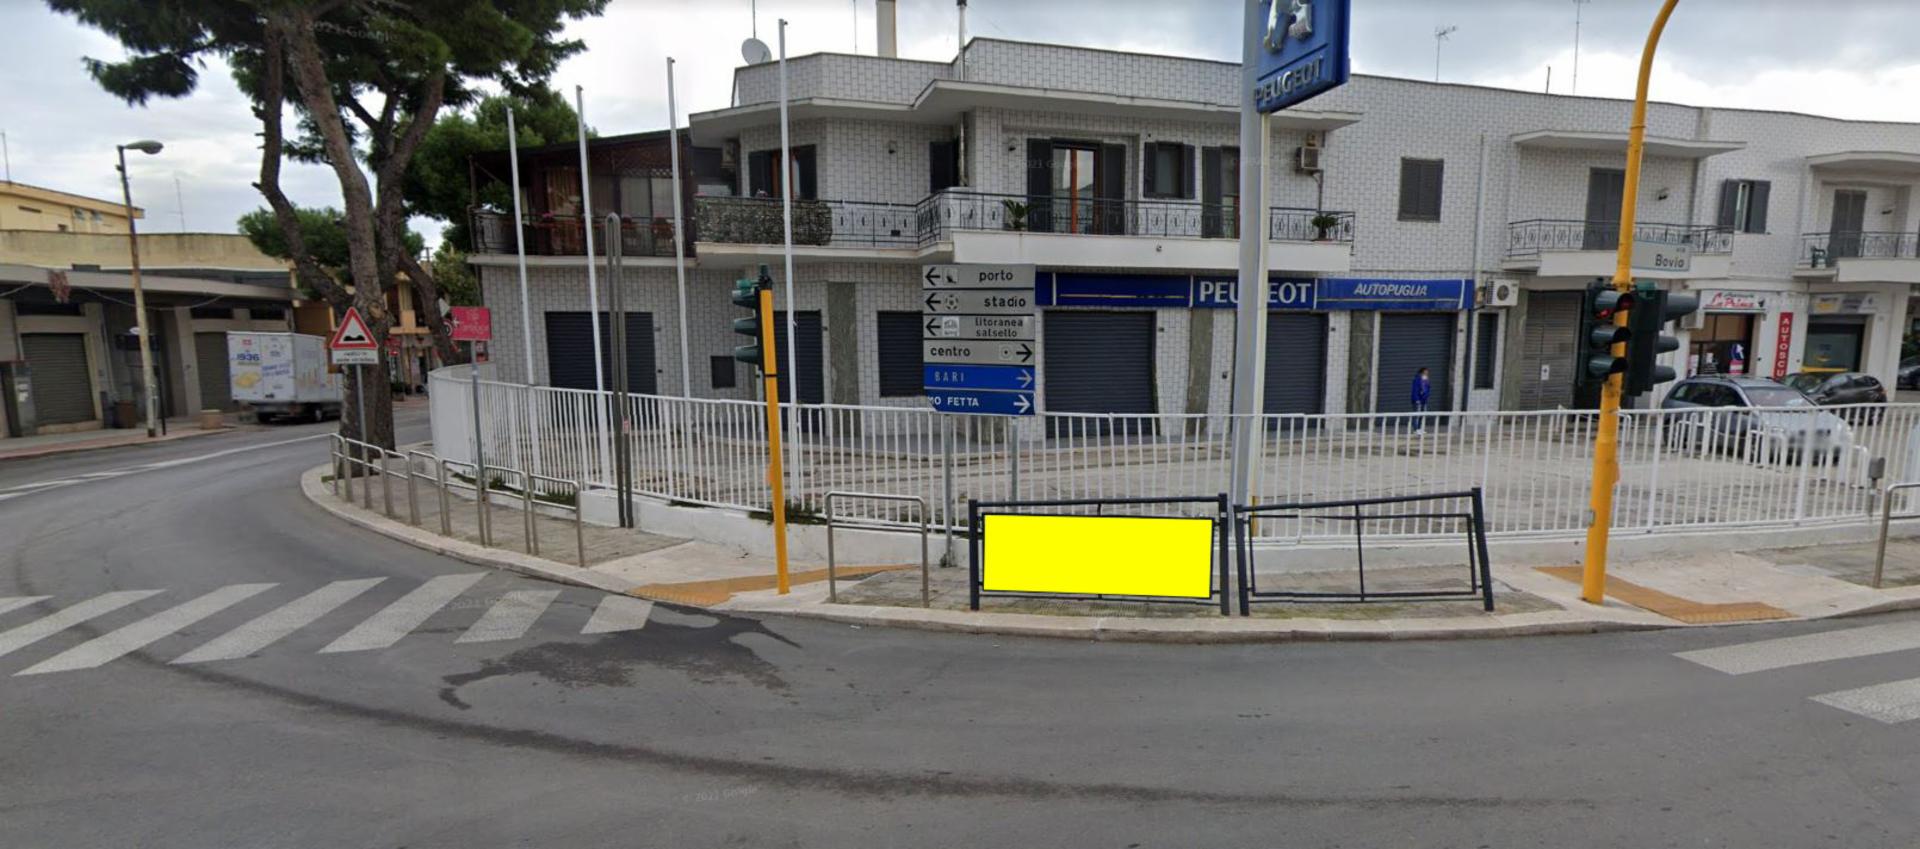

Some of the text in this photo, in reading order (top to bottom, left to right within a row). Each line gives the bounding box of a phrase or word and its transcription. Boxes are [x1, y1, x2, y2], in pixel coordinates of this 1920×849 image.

[1255, 54, 1323, 105] PEUGEOT
[1655, 253, 1685, 268] Bovio
[979, 270, 1014, 282] porto
[1353, 283, 1428, 296] AUTOPUGLIA
[984, 296, 1026, 307] stadio
[975, 318, 1023, 327] litoranea
[976, 328, 1017, 337] salsello
[930, 345, 971, 357] centro
[934, 371, 965, 382] BARI
[947, 396, 980, 407] FETTA
